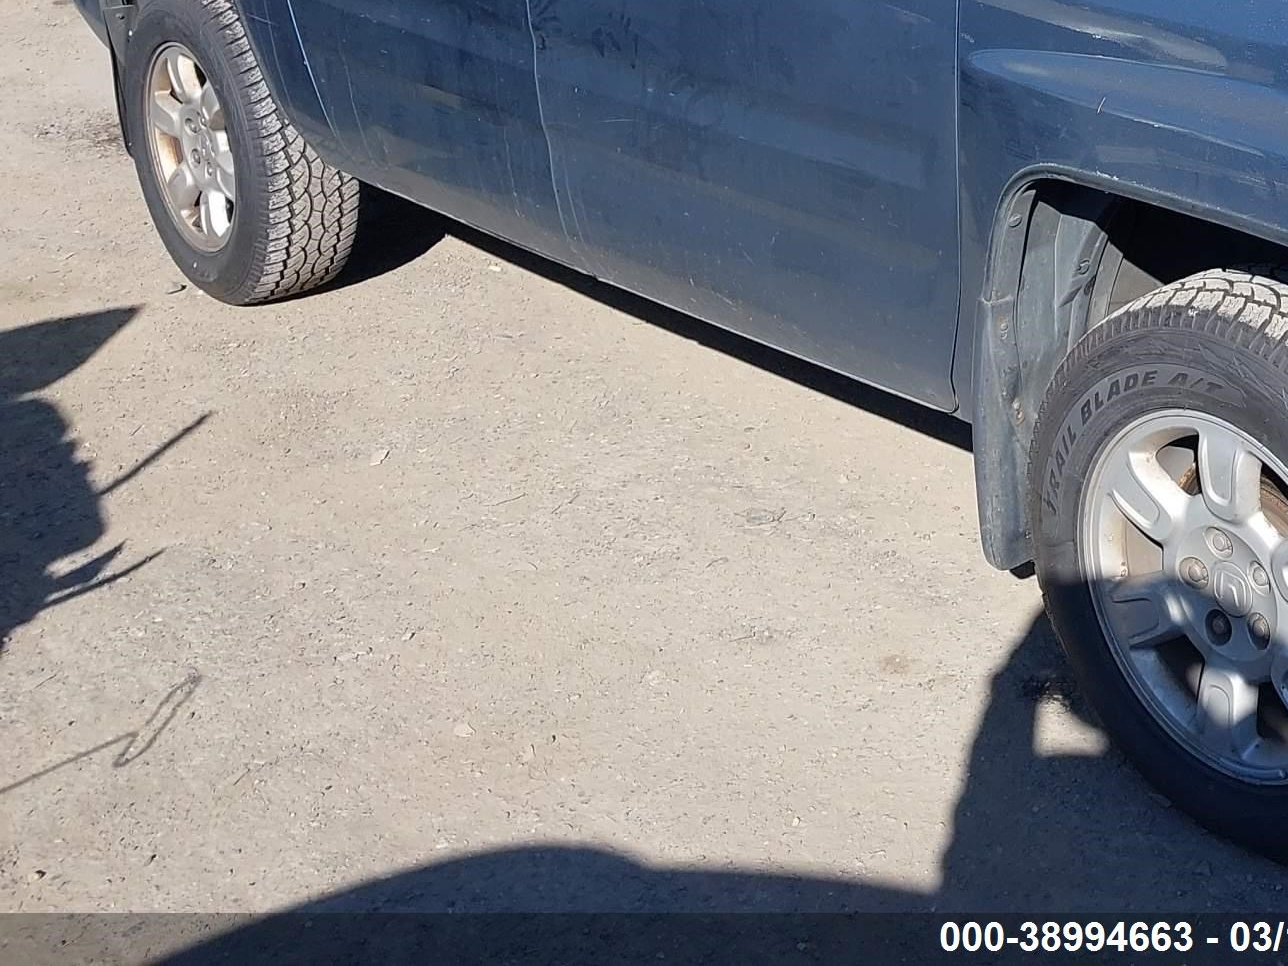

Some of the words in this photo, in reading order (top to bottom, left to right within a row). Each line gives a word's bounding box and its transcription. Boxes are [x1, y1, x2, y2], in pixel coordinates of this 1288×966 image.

[1044, 425, 1077, 515] TRAIL
[1081, 370, 1157, 424] BLADE
[1169, 372, 1224, 393] A/T
